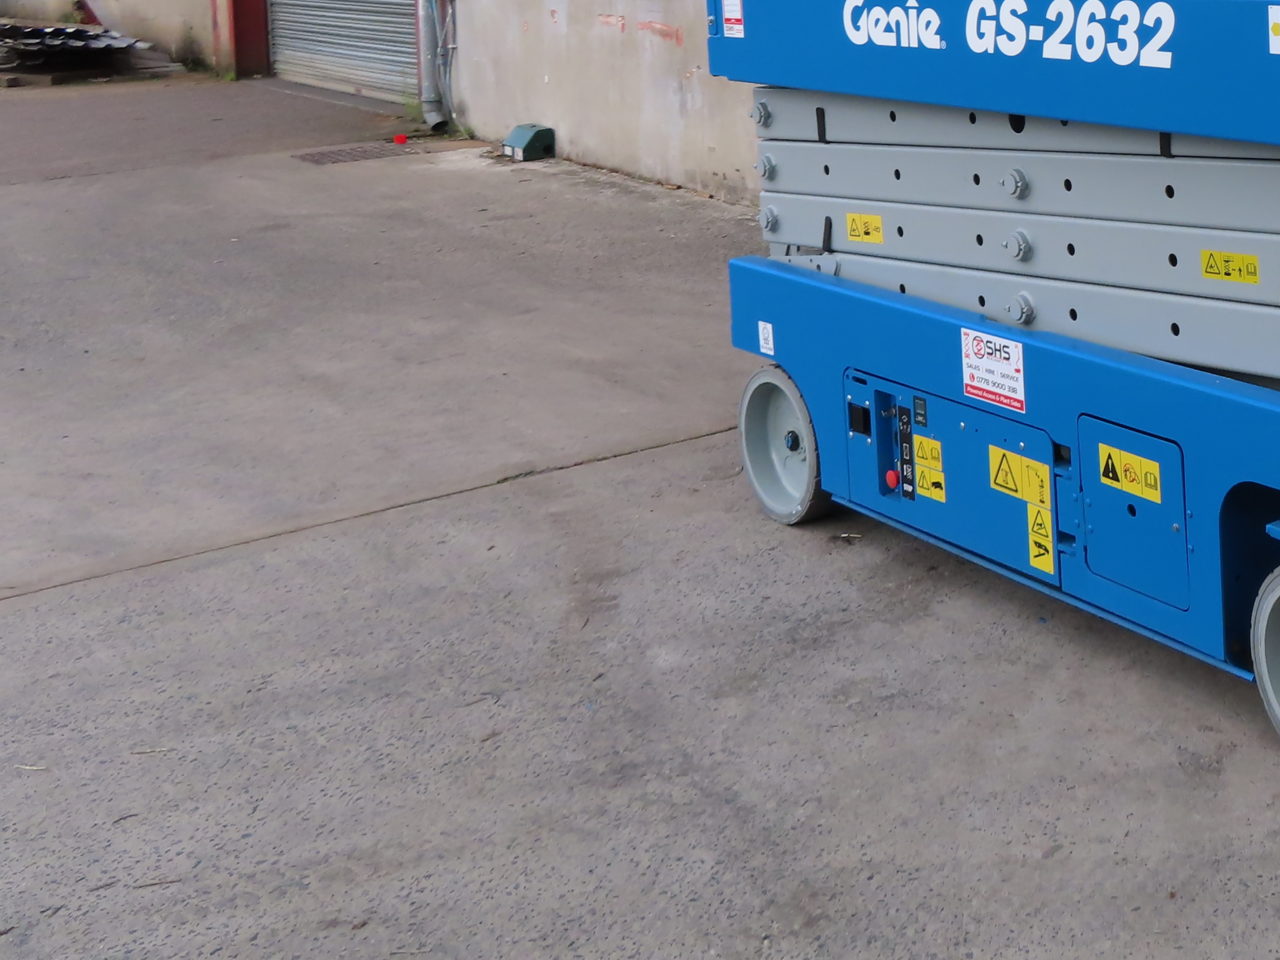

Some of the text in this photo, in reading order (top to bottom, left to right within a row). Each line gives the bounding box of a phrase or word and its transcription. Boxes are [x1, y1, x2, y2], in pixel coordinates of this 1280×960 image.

[985, 340, 1011, 360] SHS
[966, 363, 981, 371] SALES
[1000, 372, 1019, 382] SERVICE
